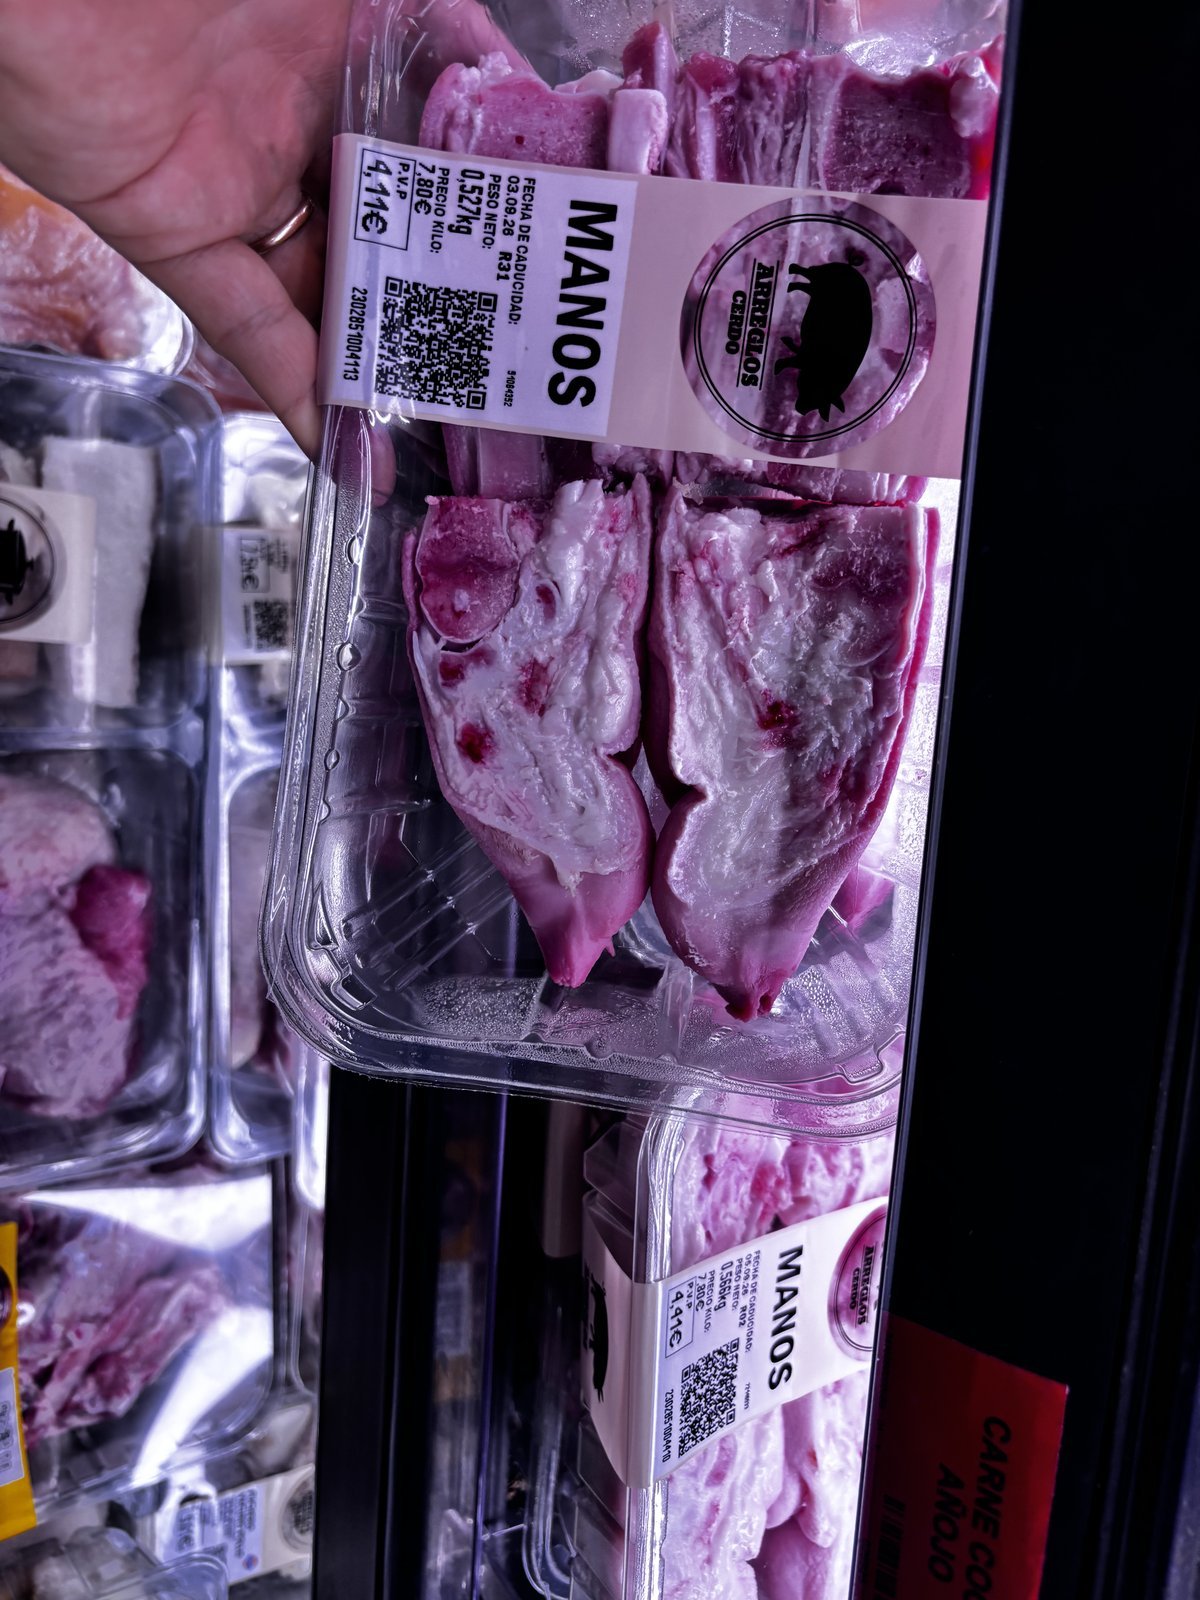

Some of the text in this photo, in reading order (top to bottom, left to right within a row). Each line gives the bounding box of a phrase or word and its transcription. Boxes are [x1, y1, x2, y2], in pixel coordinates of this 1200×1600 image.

[361, 159, 393, 236] 4,11€
[396, 161, 411, 201] P.V.P
[414, 161, 436, 216] 7,80€
[429, 167, 450, 254] PRECIO KILO:
[447, 168, 485, 236] 0,527kg
[482, 173, 502, 250] PESO NETO:
[497, 175, 520, 281] 03.09.26 R31
[508, 177, 536, 325] FECHA DE CADUCIDAD:
[343, 286, 368, 381] 2302851004113
[548, 200, 618, 407] MANOS
[725, 290, 747, 355] CERDO
[741, 262, 775, 387] ARREGLOS
[669, 1290, 684, 1348] 4,41€
[685, 1281, 694, 1309] P.V.P
[695, 1273, 707, 1312] 7,80€
[703, 1269, 716, 1334] PRECIO KILO:
[713, 1260, 734, 1312] 0,566kg
[731, 1257, 743, 1311] PESO NETO:
[738, 1305, 747, 1328] R02
[745, 1249, 761, 1353] FECHA DE CADUCIDAD:
[768, 1244, 803, 1391] MANOS
[849, 1267, 860, 1311] CERDO
[857, 1245, 875, 1326] ARREGLOS
[662, 1388, 674, 1463] 2302851004410
[971, 1416, 1012, 1539] CARNE
[927, 1462, 967, 1584] AÑOJO
